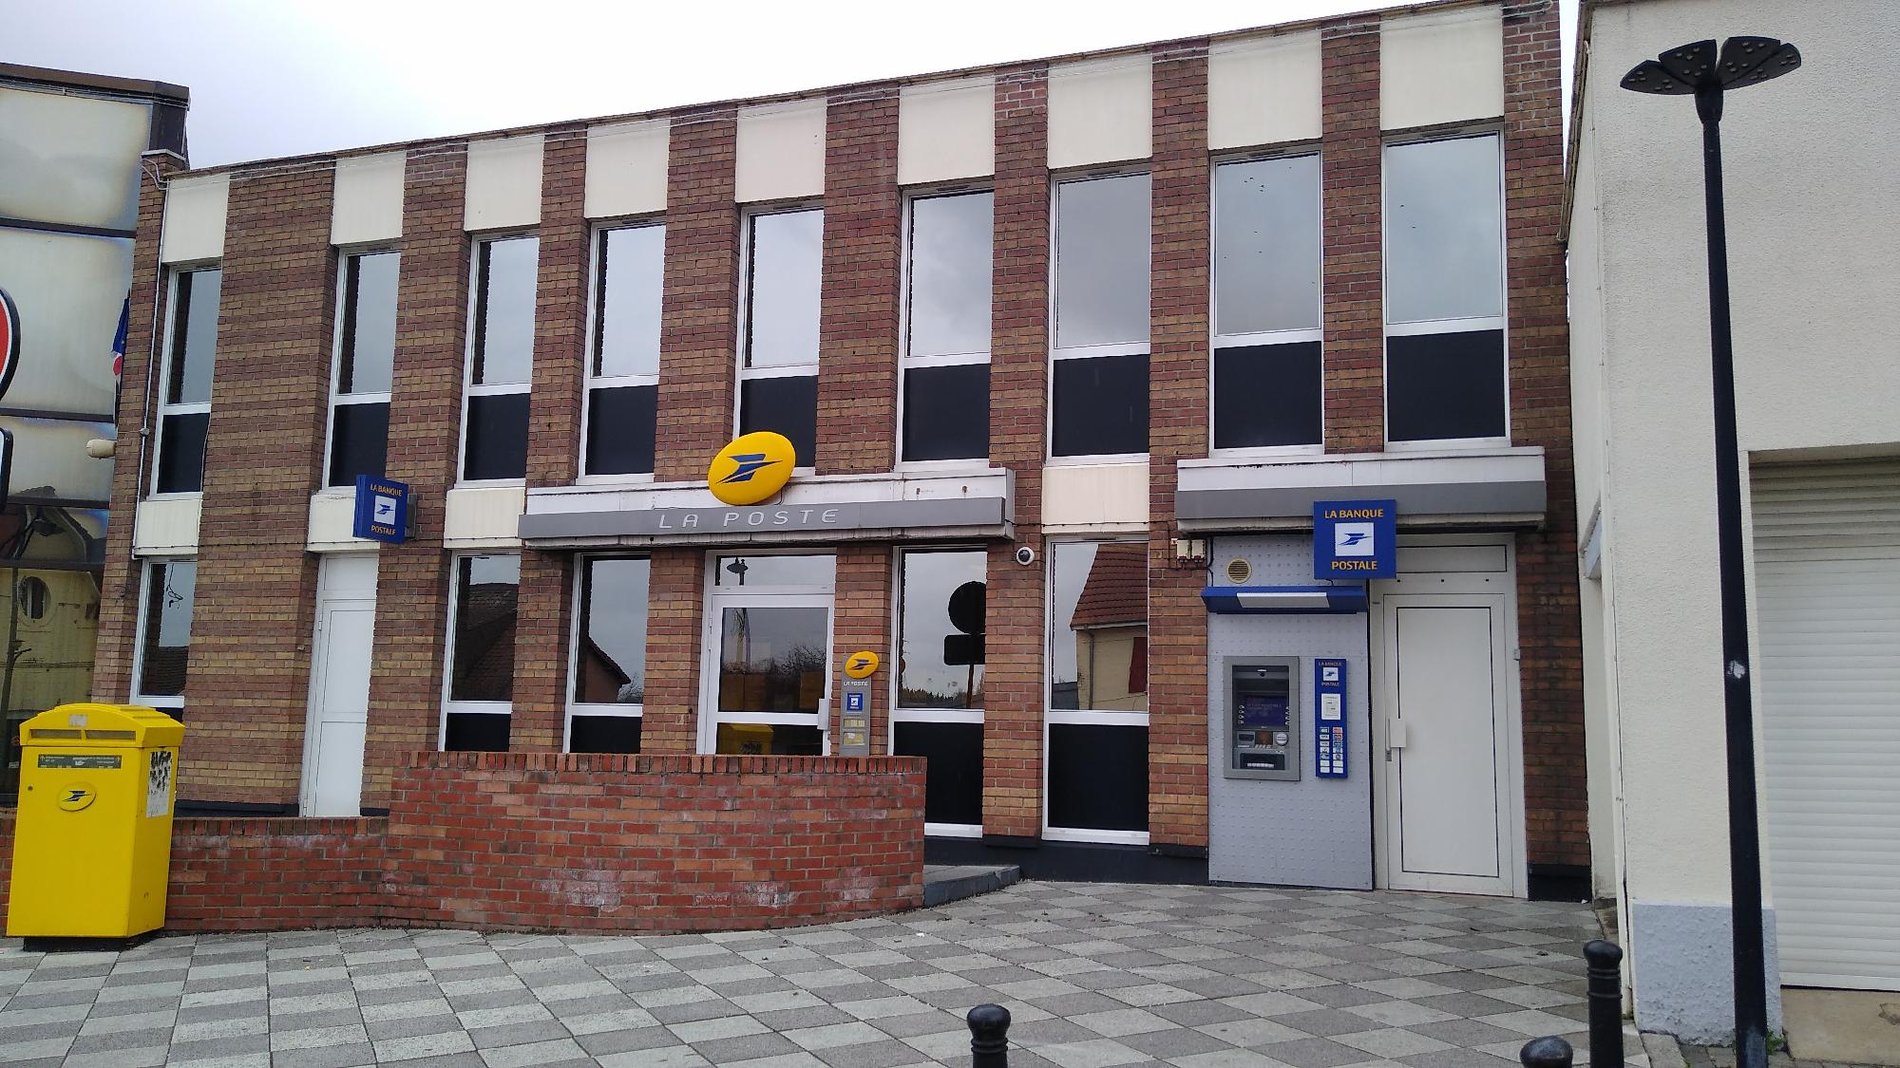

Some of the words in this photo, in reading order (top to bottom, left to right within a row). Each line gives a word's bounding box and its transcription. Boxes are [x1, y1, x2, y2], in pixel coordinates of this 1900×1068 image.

[370, 483, 377, 492] LA
[378, 485, 402, 497] BANQUE
[658, 513, 699, 529] LA
[723, 508, 839, 527] POSTE
[1324, 510, 1337, 519] LA
[1339, 508, 1384, 519] BANQUE
[371, 525, 396, 535] POSTALE
[1331, 561, 1378, 570] POSTALE
